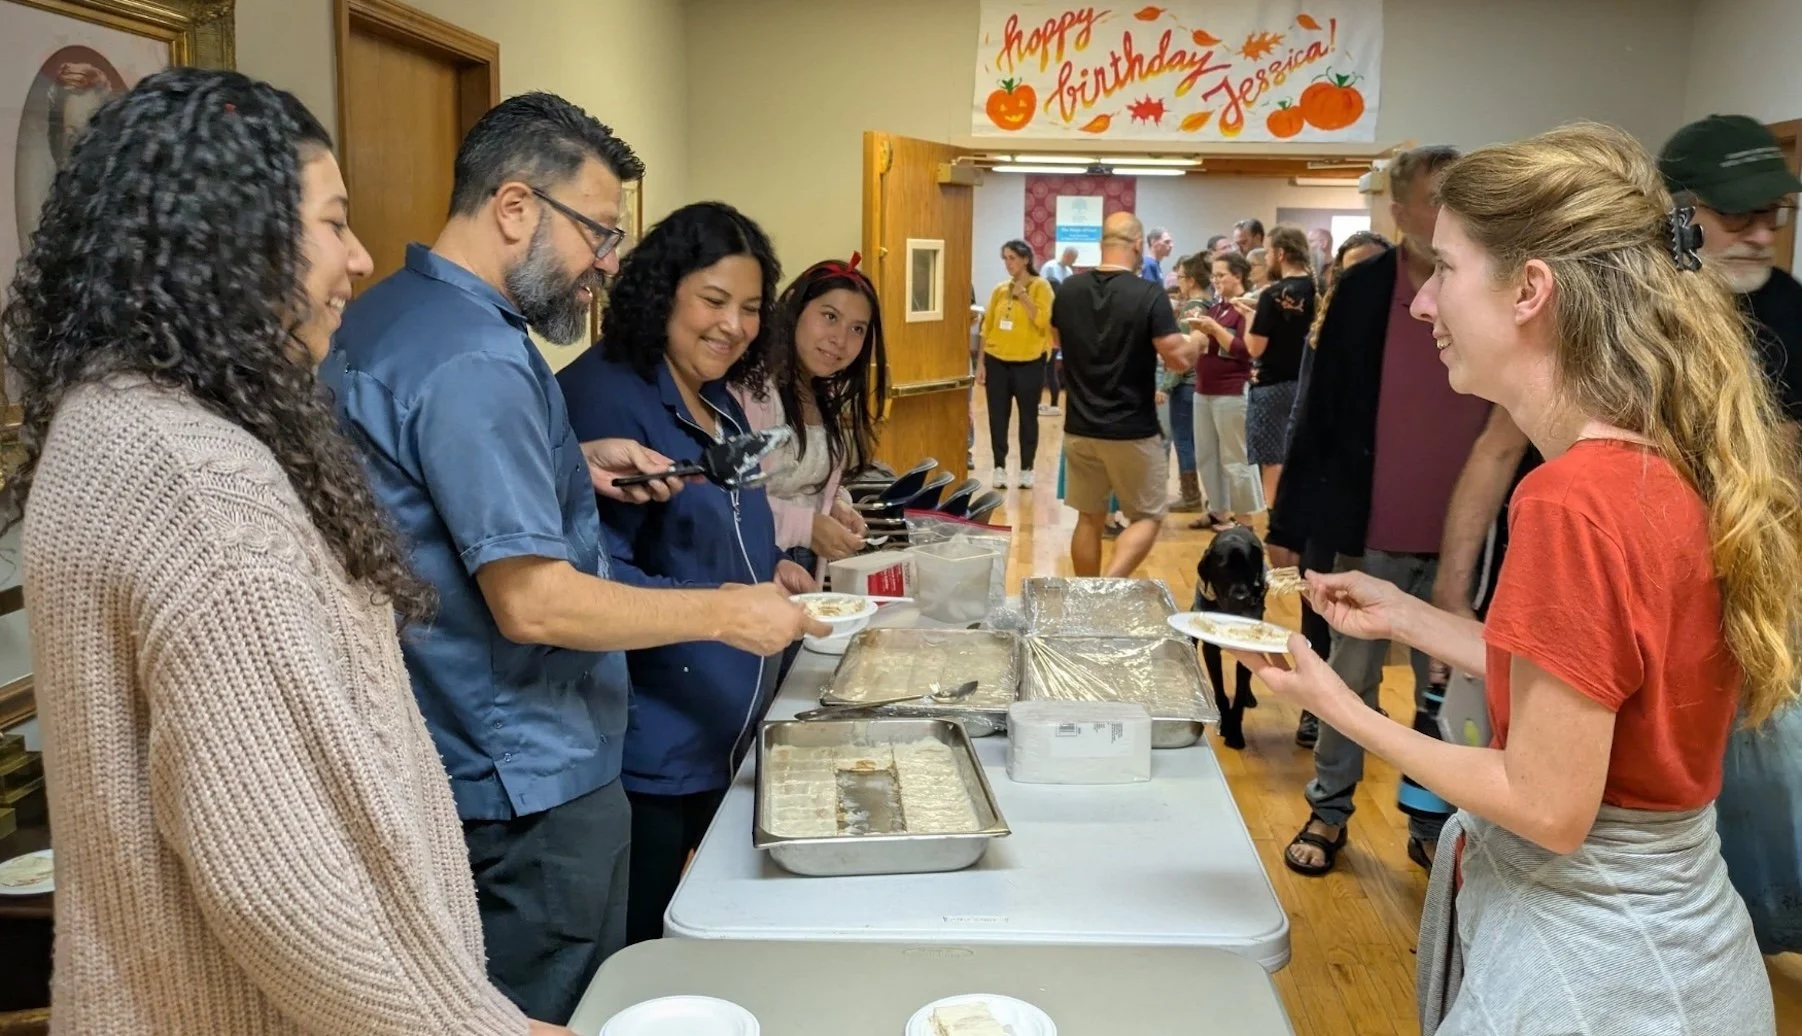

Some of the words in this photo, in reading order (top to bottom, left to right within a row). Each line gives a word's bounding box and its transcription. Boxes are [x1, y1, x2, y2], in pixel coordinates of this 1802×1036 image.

[996, 7, 1112, 73] happy
[1043, 29, 1232, 123] birthday
[1201, 18, 1337, 138] Jessica!
